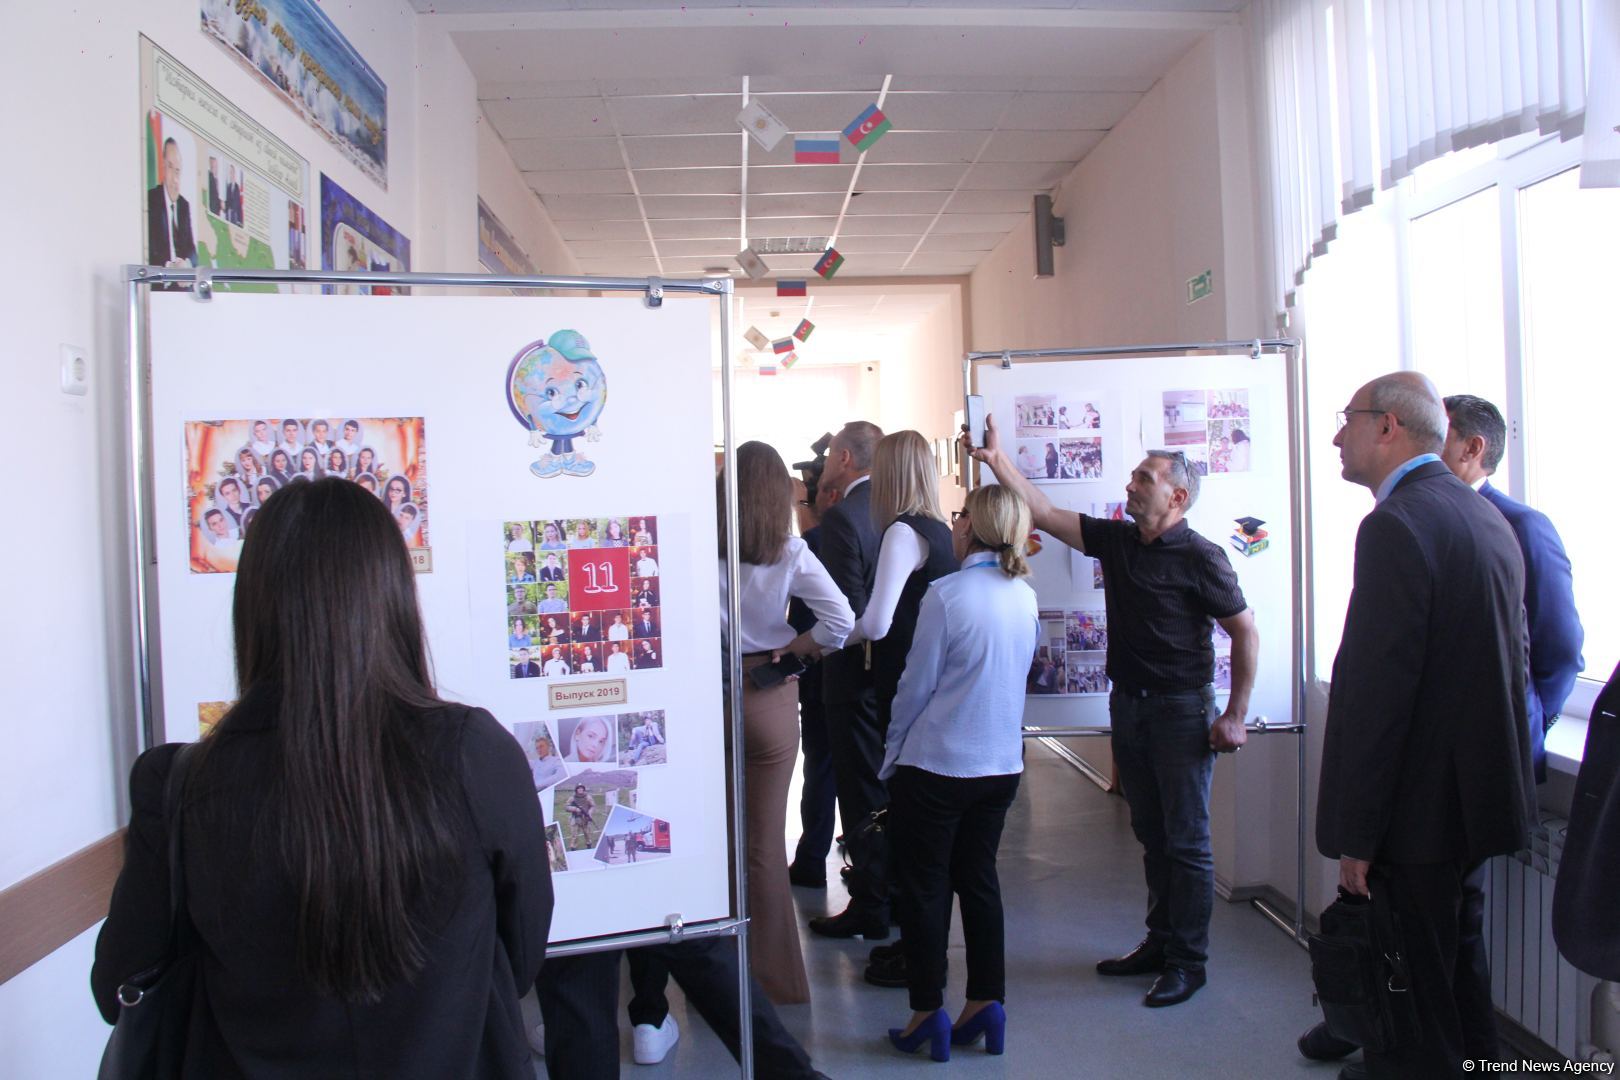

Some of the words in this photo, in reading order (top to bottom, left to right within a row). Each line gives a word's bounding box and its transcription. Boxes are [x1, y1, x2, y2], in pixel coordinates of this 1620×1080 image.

[414, 555, 425, 565] 18
[582, 561, 619, 594] 11
[555, 691, 595, 701] Выпуск
[597, 687, 620, 697] 2019
